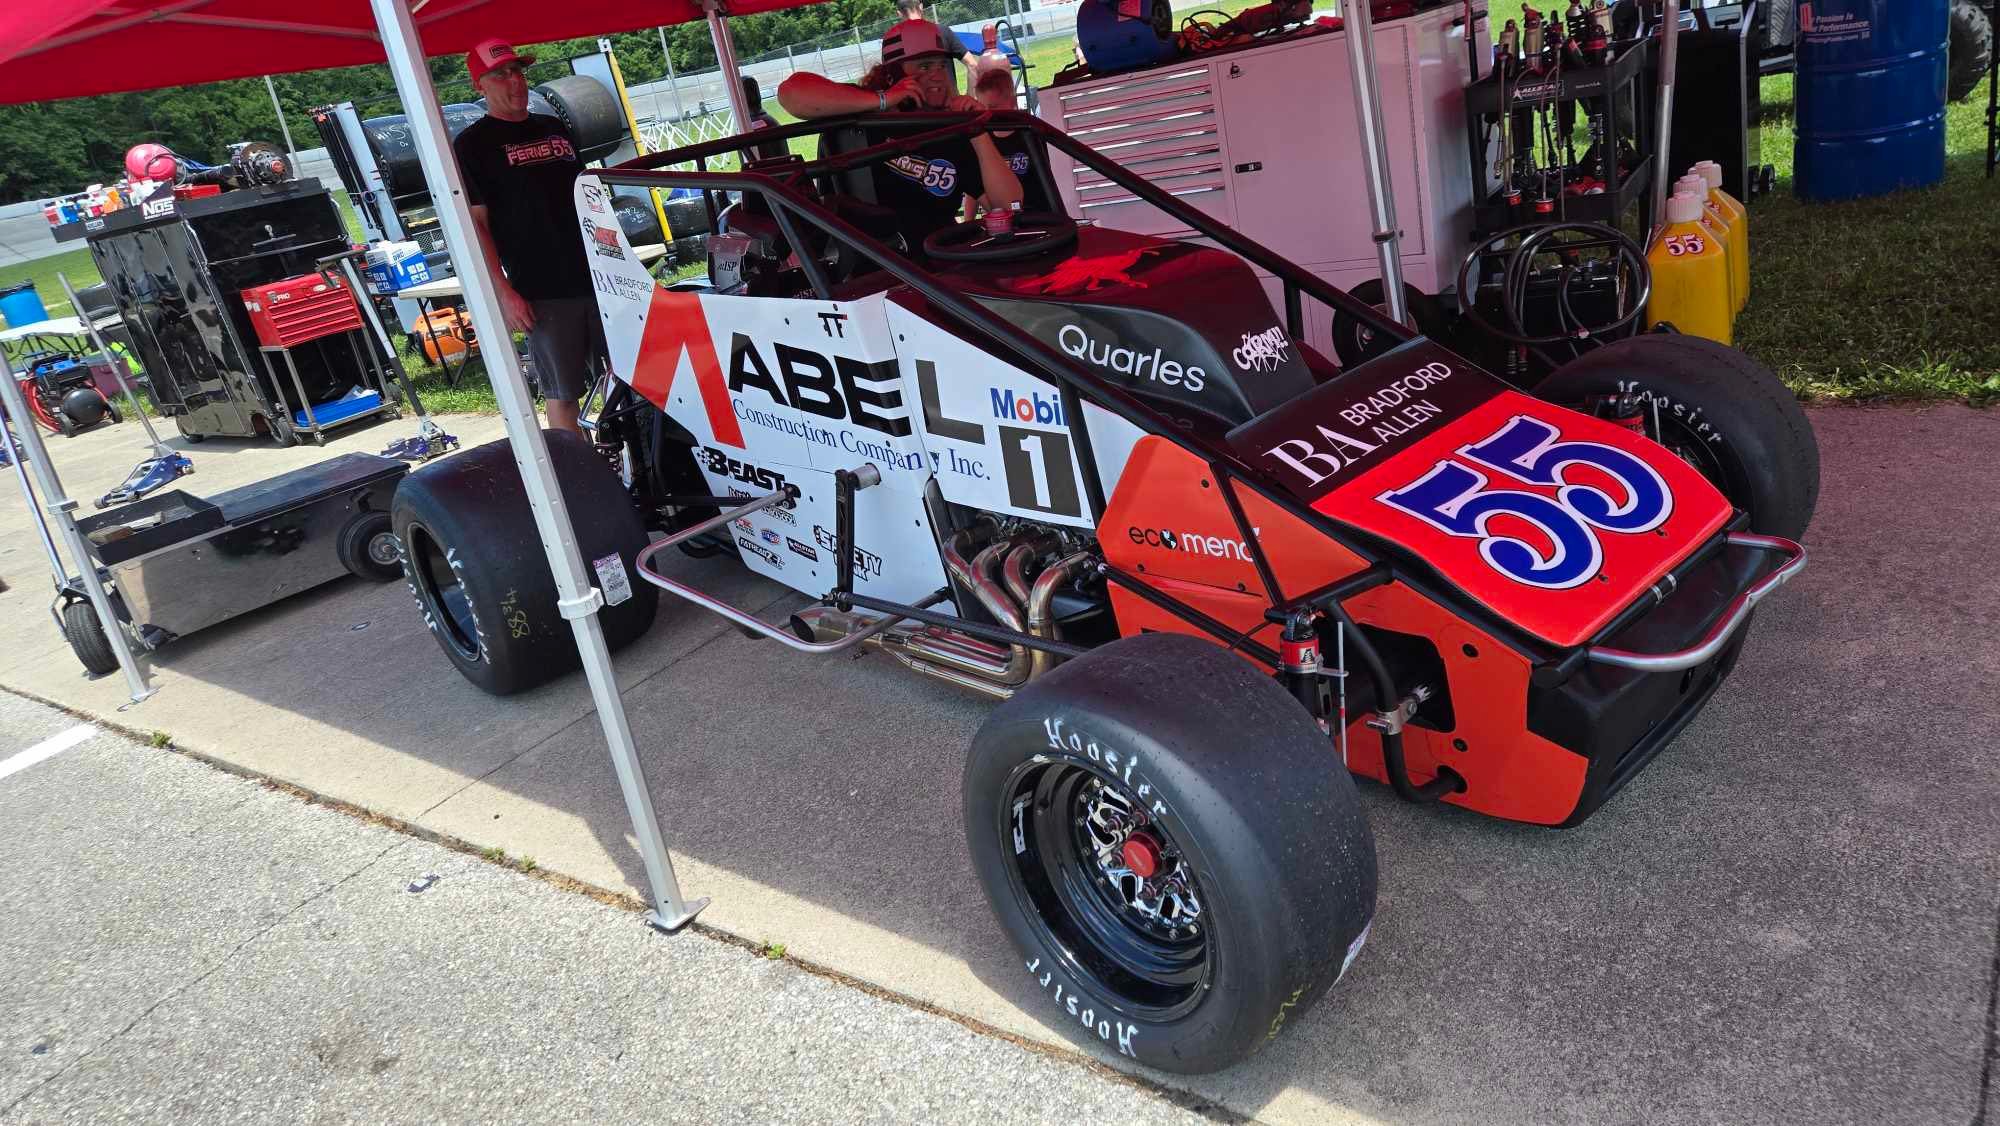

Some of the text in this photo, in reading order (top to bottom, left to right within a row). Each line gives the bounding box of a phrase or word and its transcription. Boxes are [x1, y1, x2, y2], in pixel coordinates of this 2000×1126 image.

[142, 197, 176, 216] NOS
[923, 163, 957, 191] 55
[1663, 234, 1704, 256] 55
[728, 331, 986, 446] ABEL
[1058, 324, 1206, 393] Quarles
[1339, 361, 1452, 427] BRADFORD
[732, 397, 991, 481] Construction Company Inc.
[989, 386, 1070, 427] Mobil
[1261, 399, 1443, 488] BA ALLEN
[1373, 414, 1675, 590] 55
[1043, 716, 1167, 815] Hoosier
[1026, 957, 1139, 1058] Hoosier
